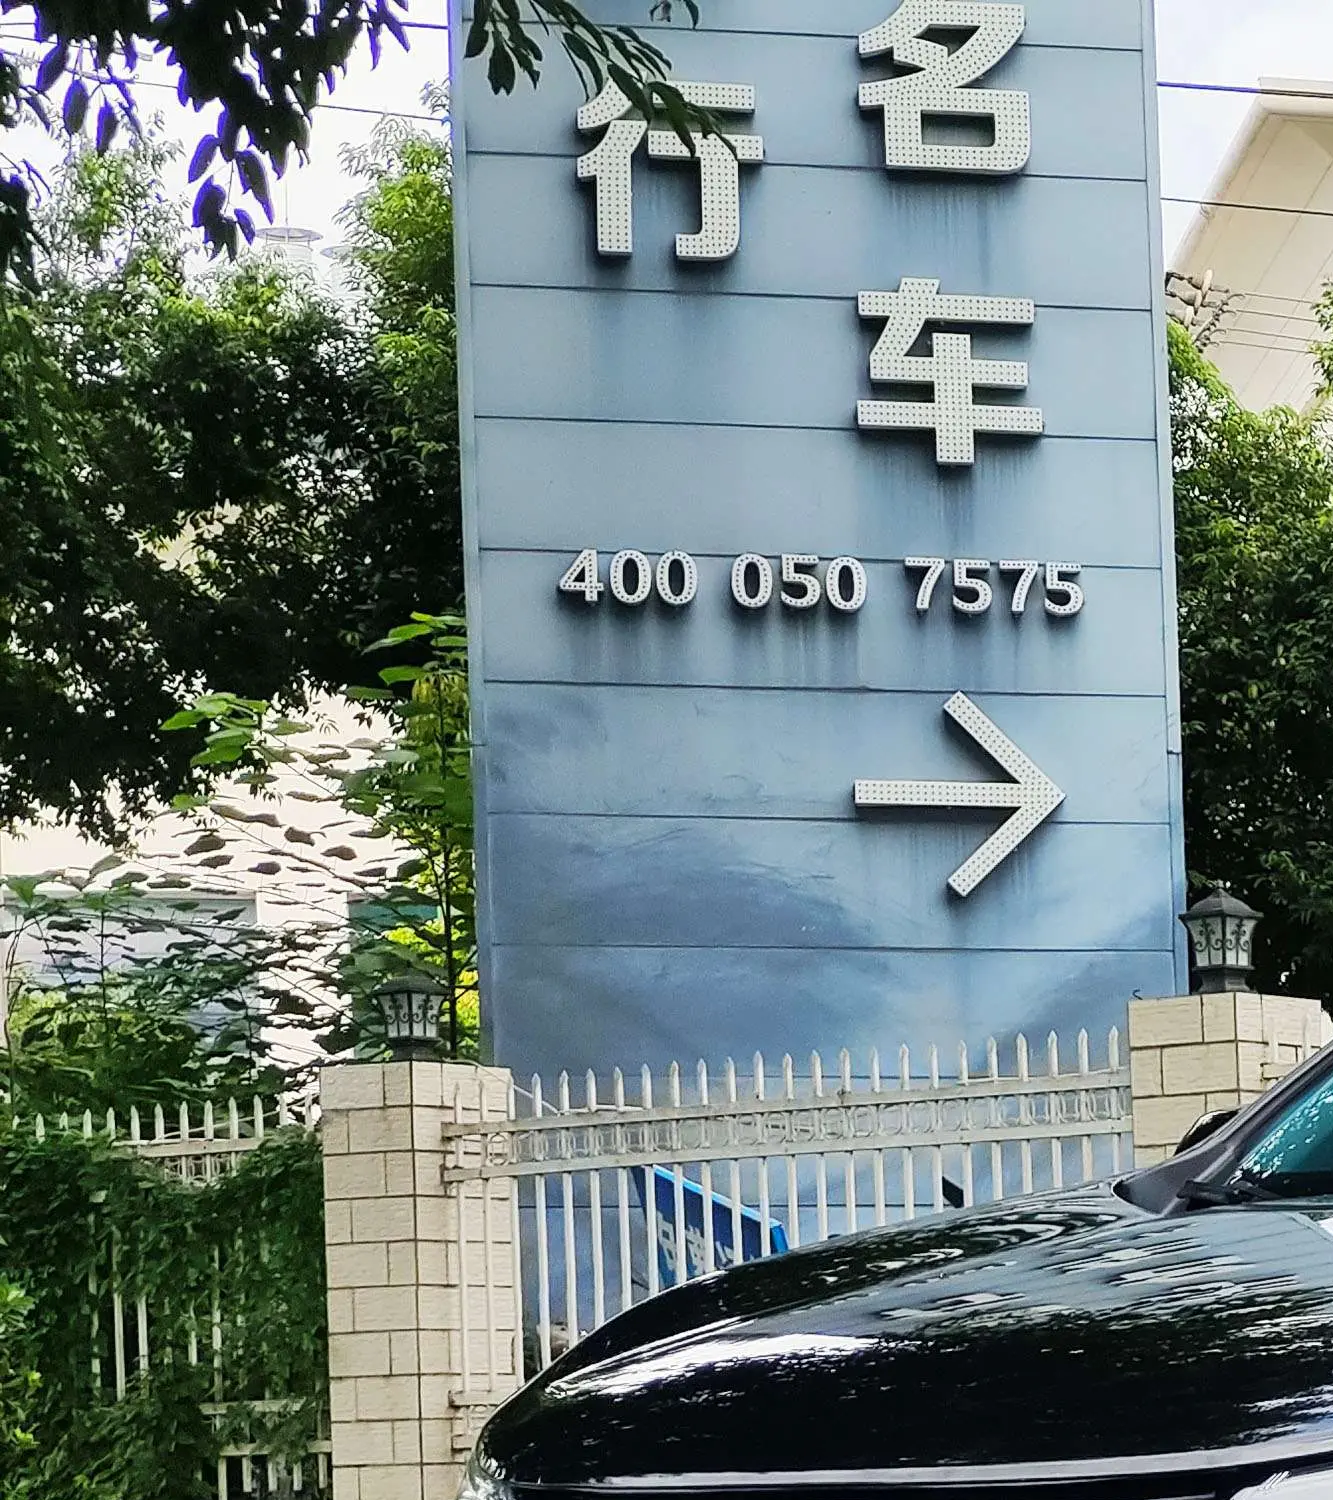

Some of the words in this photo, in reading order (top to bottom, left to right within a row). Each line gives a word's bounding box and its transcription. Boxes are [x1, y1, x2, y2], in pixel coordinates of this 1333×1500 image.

[577, 78, 765, 262] 行
[558, 547, 699, 607] 400
[730, 551, 868, 614] 050
[904, 556, 1085, 618] 7575
